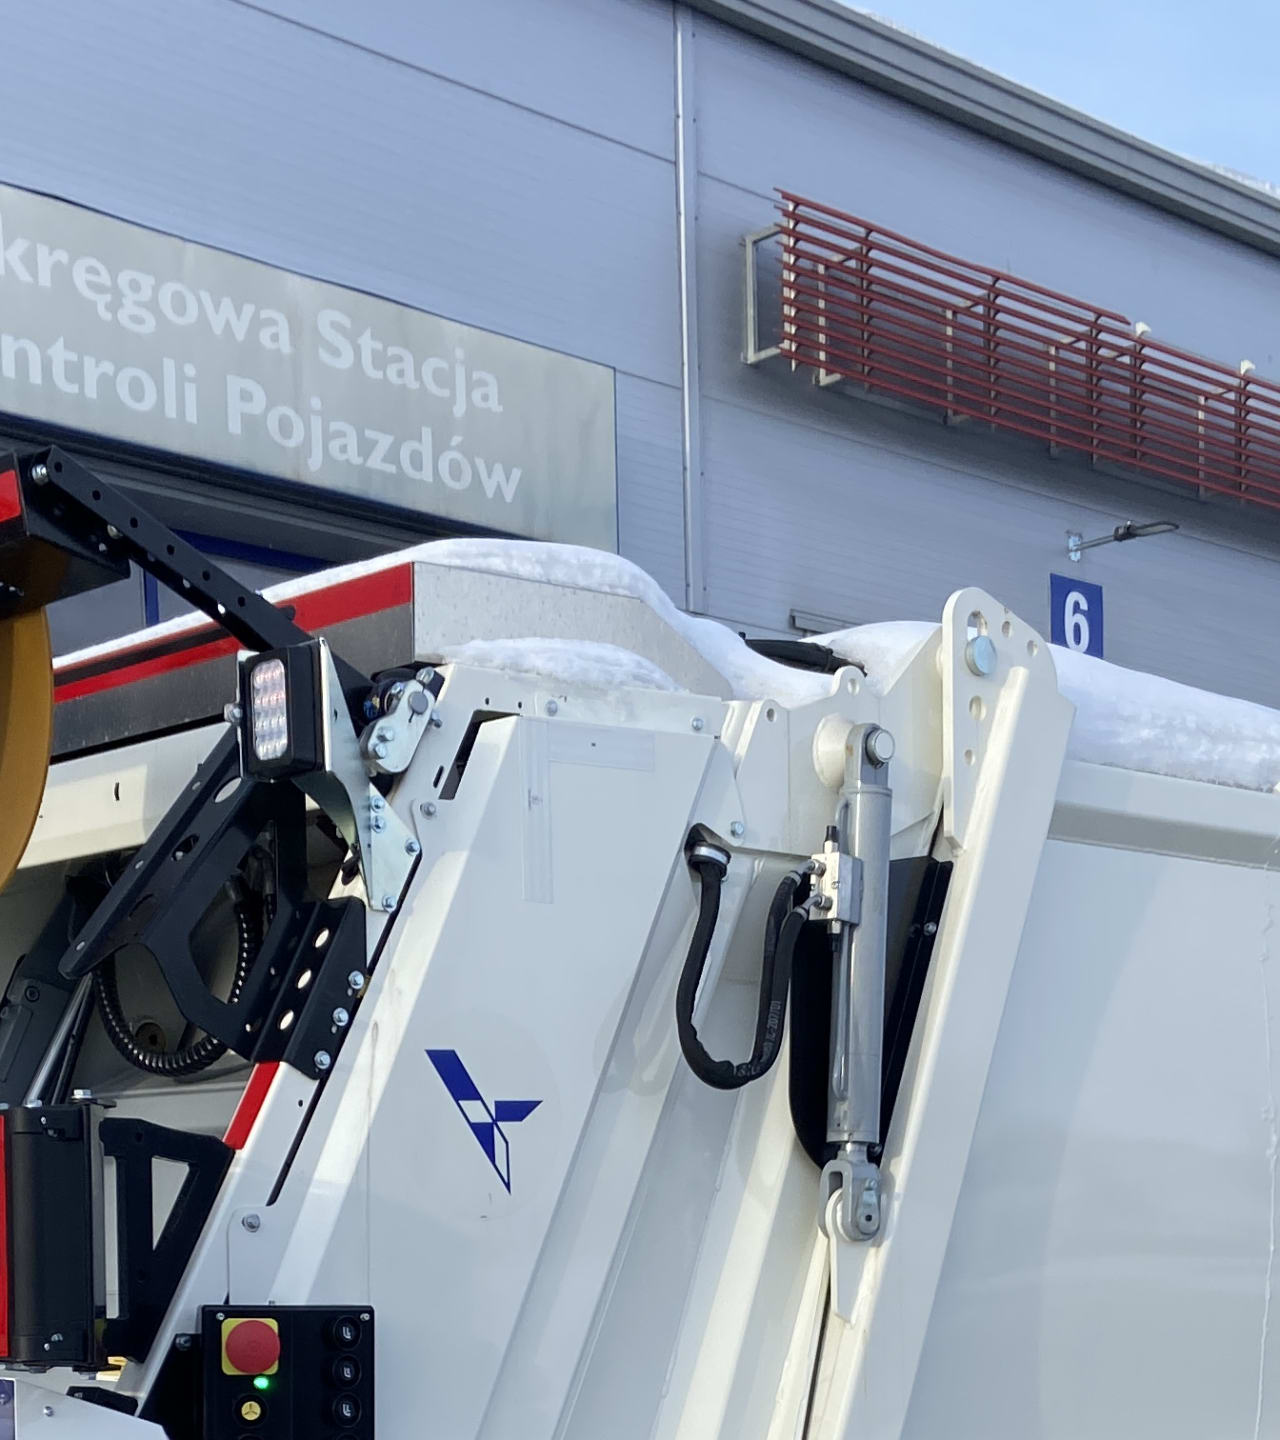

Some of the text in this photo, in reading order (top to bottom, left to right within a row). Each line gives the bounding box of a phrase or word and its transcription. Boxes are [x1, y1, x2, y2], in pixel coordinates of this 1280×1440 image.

[317, 308, 504, 418] Stacja
[225, 374, 523, 503] Pojazdów
[1064, 591, 1090, 653] 6
